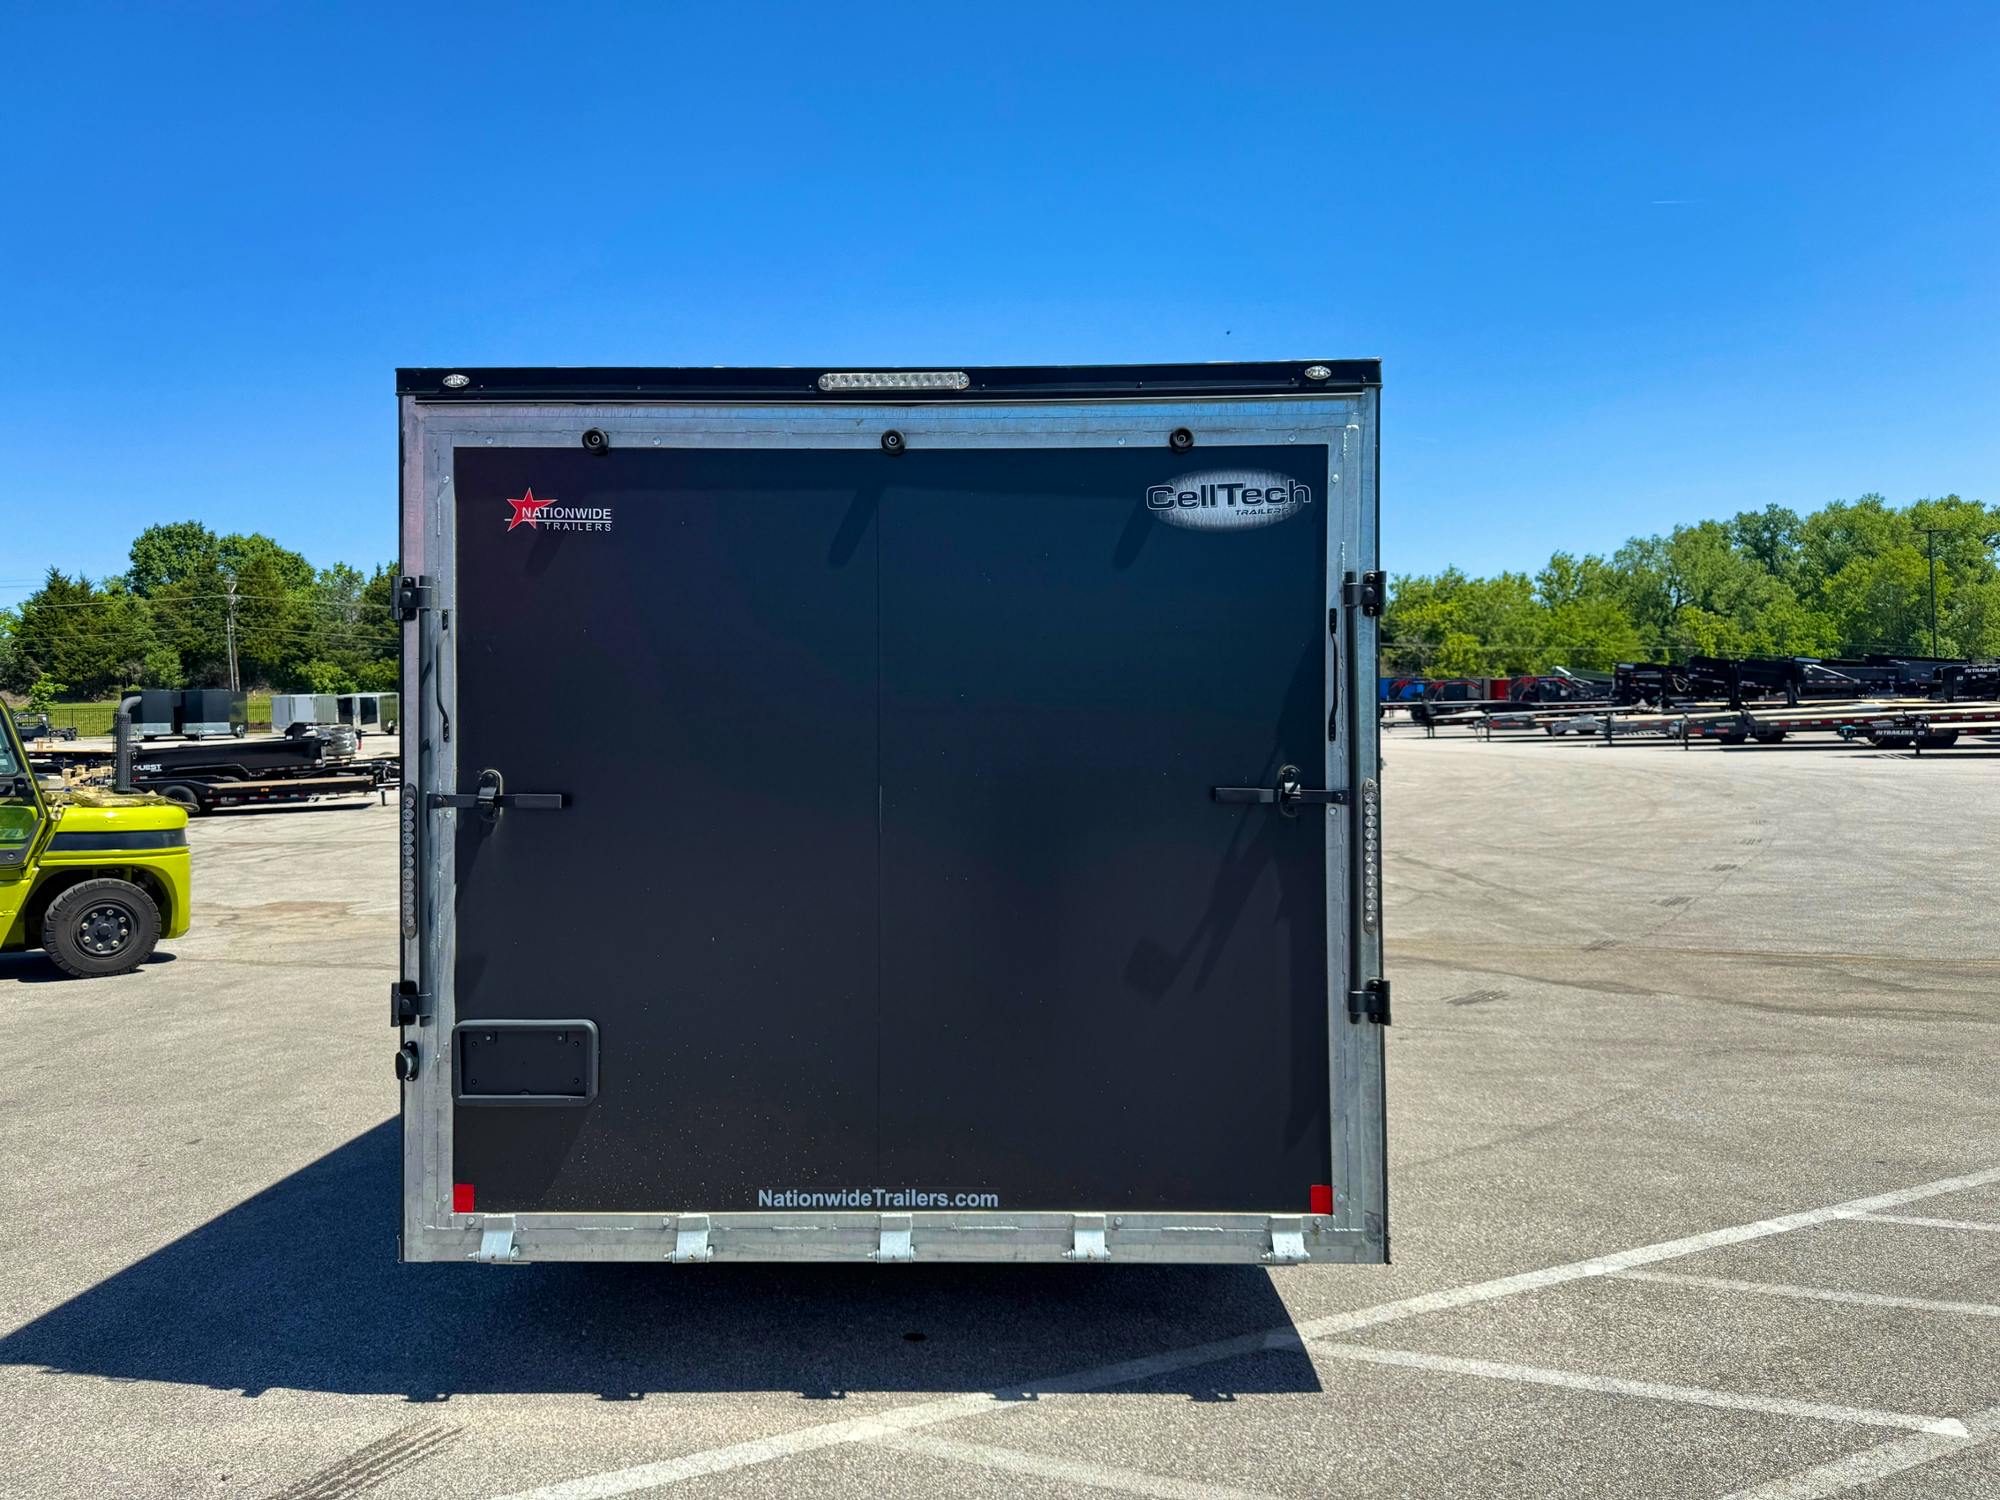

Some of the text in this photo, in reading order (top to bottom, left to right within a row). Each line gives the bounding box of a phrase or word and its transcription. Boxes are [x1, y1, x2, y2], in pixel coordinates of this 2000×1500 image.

[1147, 479, 1311, 510] CellTech
[522, 507, 612, 519] NATIONWIDE
[1236, 507, 1289, 516] TRAILERS
[545, 522, 611, 531] TRAILERS
[758, 1189, 999, 1207] NationwideTrailers.com
